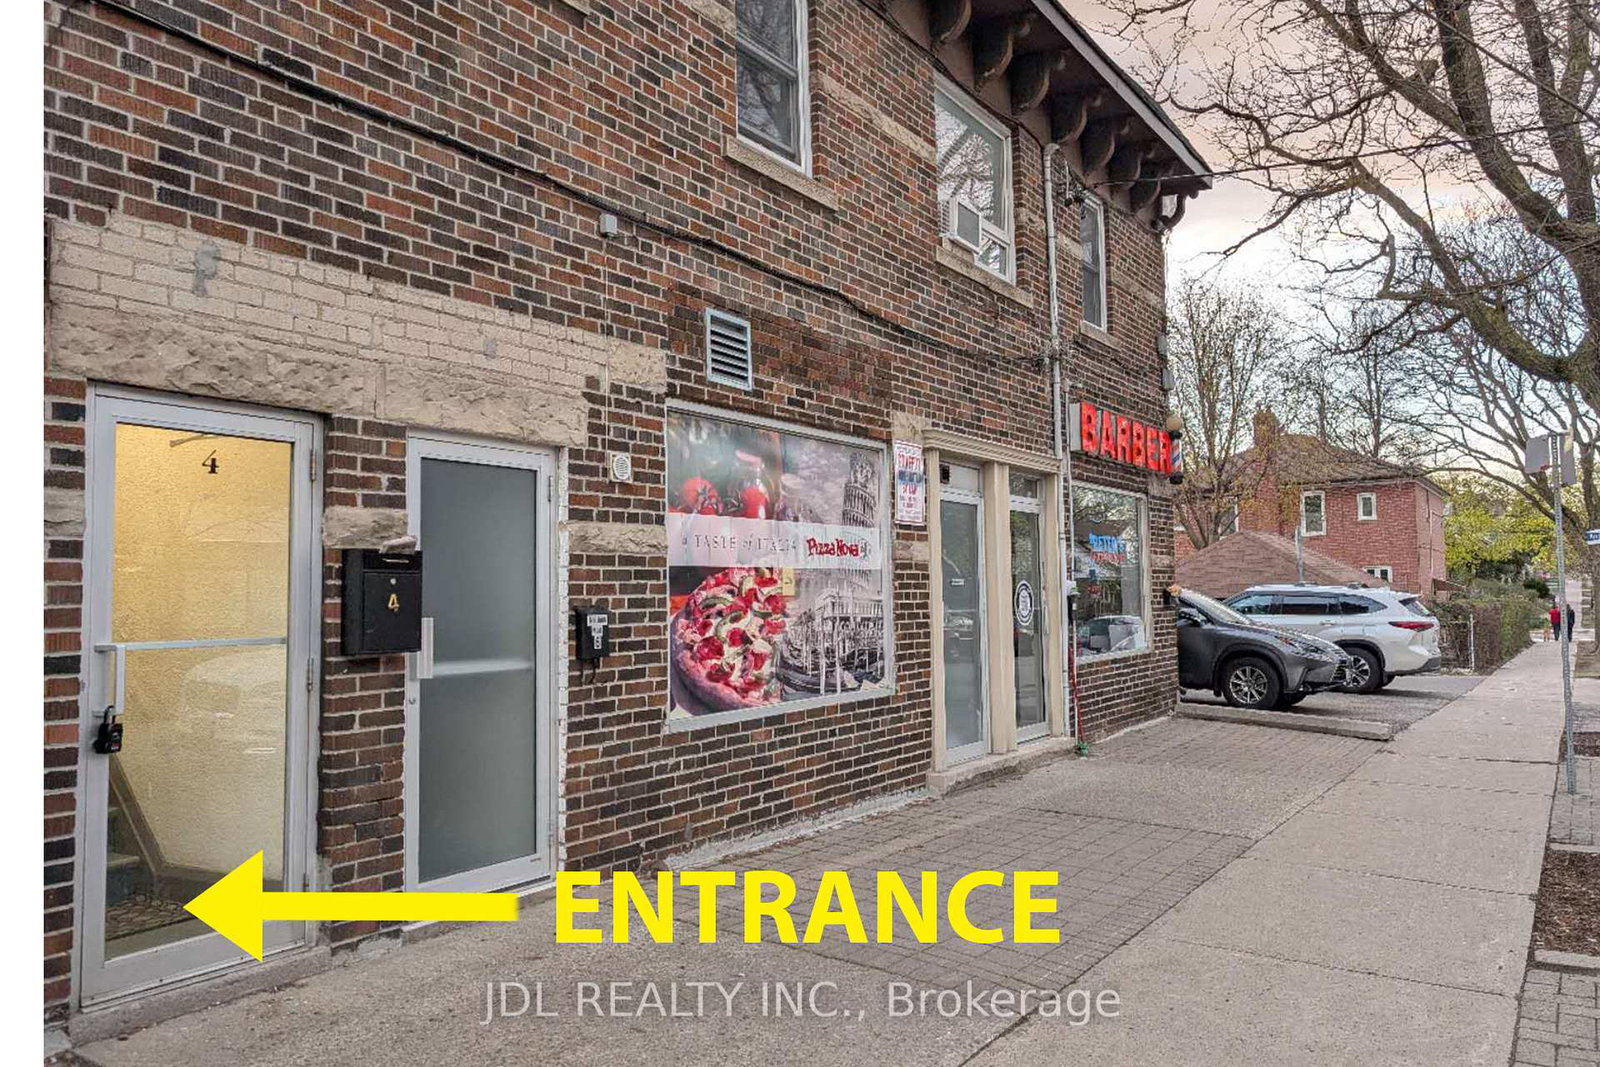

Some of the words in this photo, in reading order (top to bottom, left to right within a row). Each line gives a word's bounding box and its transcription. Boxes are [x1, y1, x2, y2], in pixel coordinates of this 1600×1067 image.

[1080, 401, 1172, 475] BARBER
[201, 449, 220, 474] 4
[694, 534, 737, 549] TASTE
[806, 537, 836, 557] Pizza
[835, 538, 860, 557] Nova
[387, 593, 400, 612] 4
